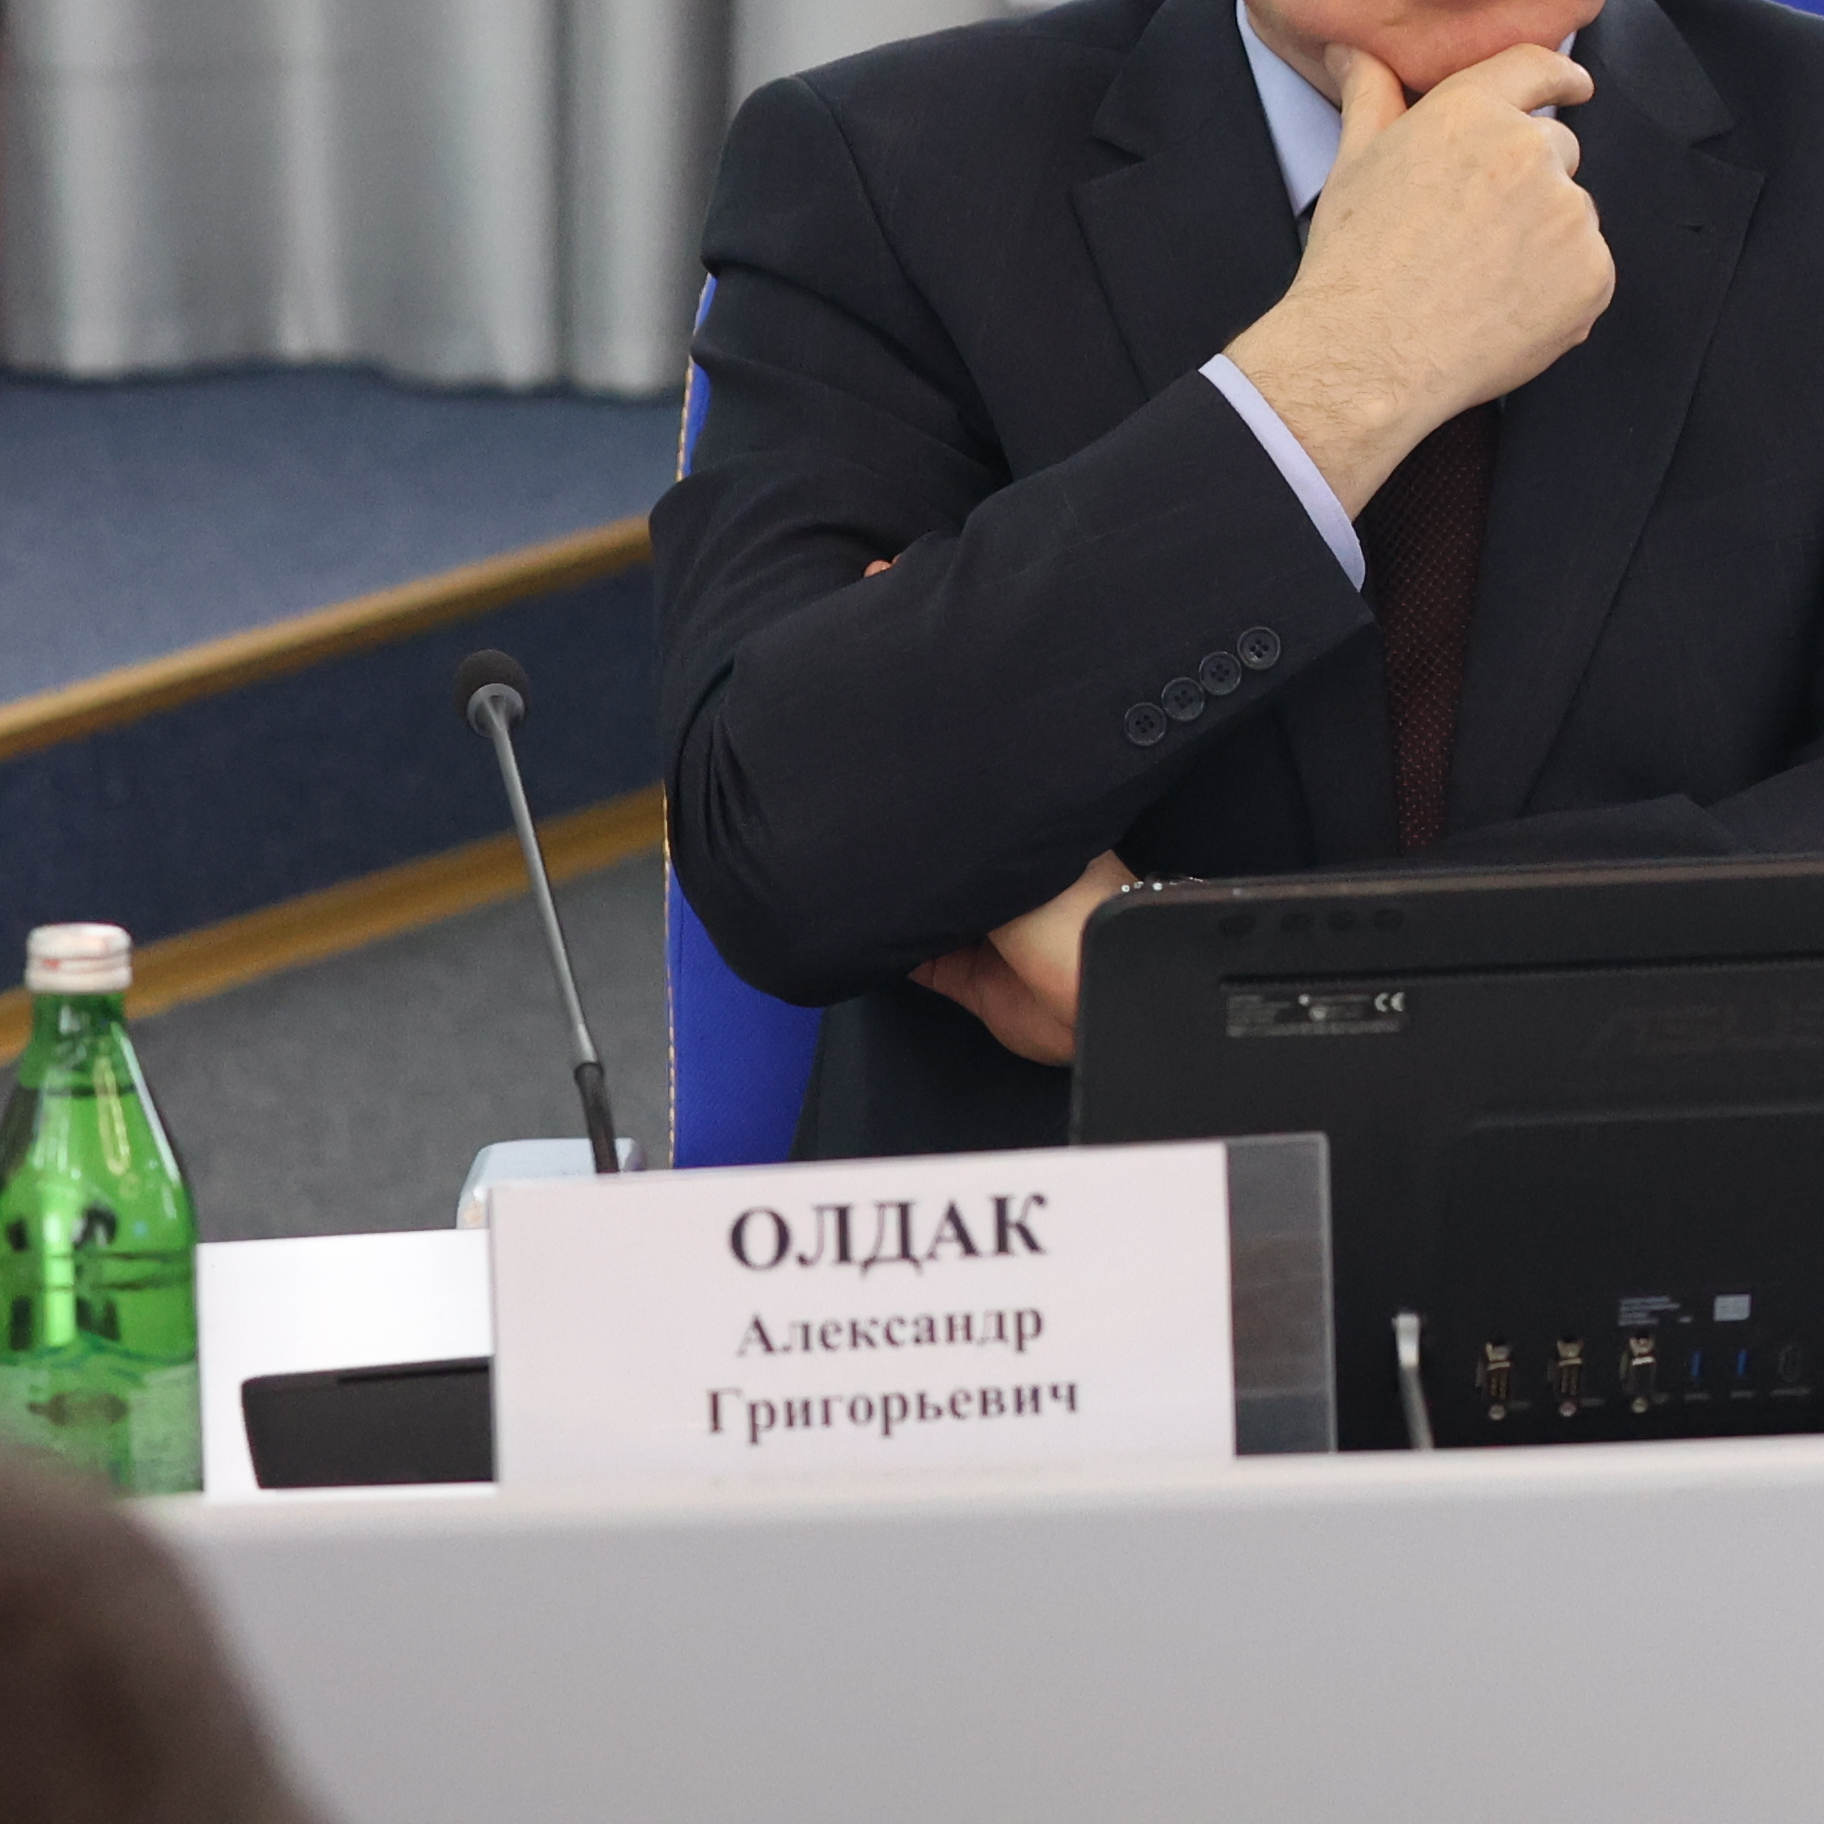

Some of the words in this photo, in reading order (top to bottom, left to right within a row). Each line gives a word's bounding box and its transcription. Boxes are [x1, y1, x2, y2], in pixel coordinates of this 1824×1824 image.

[729, 1193, 1047, 1274] ОЛДАК
[736, 1307, 1044, 1356] Александр
[709, 1382, 1078, 1444] Григорьевич
